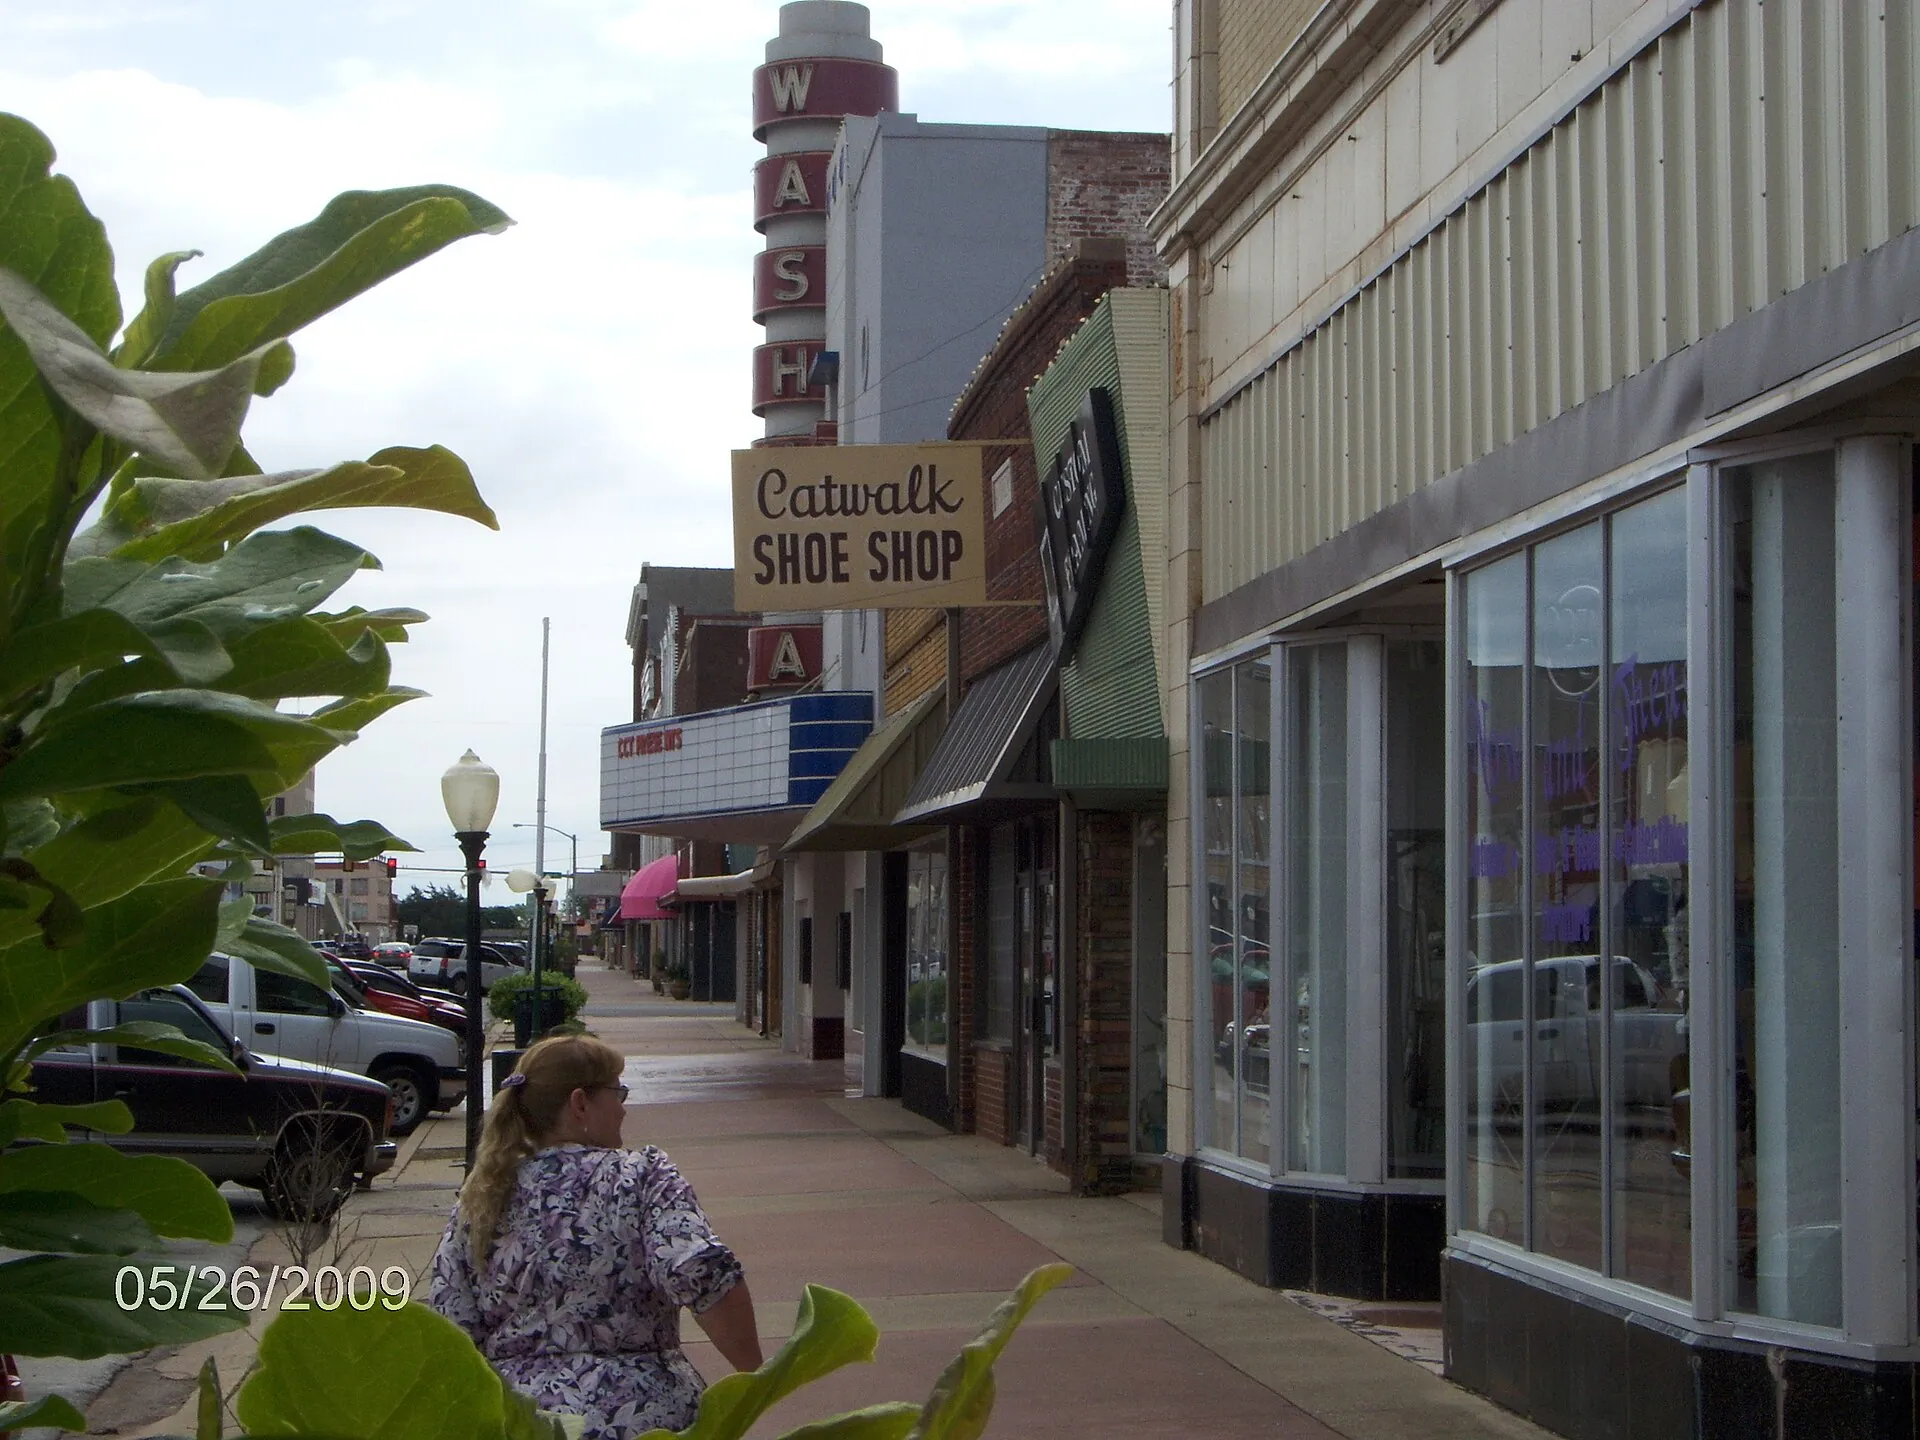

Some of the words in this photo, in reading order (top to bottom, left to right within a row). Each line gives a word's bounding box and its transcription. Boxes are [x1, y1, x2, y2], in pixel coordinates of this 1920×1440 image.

[767, 64, 814, 680] WASHA
[757, 463, 965, 520] Catwalk
[753, 531, 850, 586] SHOE
[867, 529, 964, 582] SHOP
